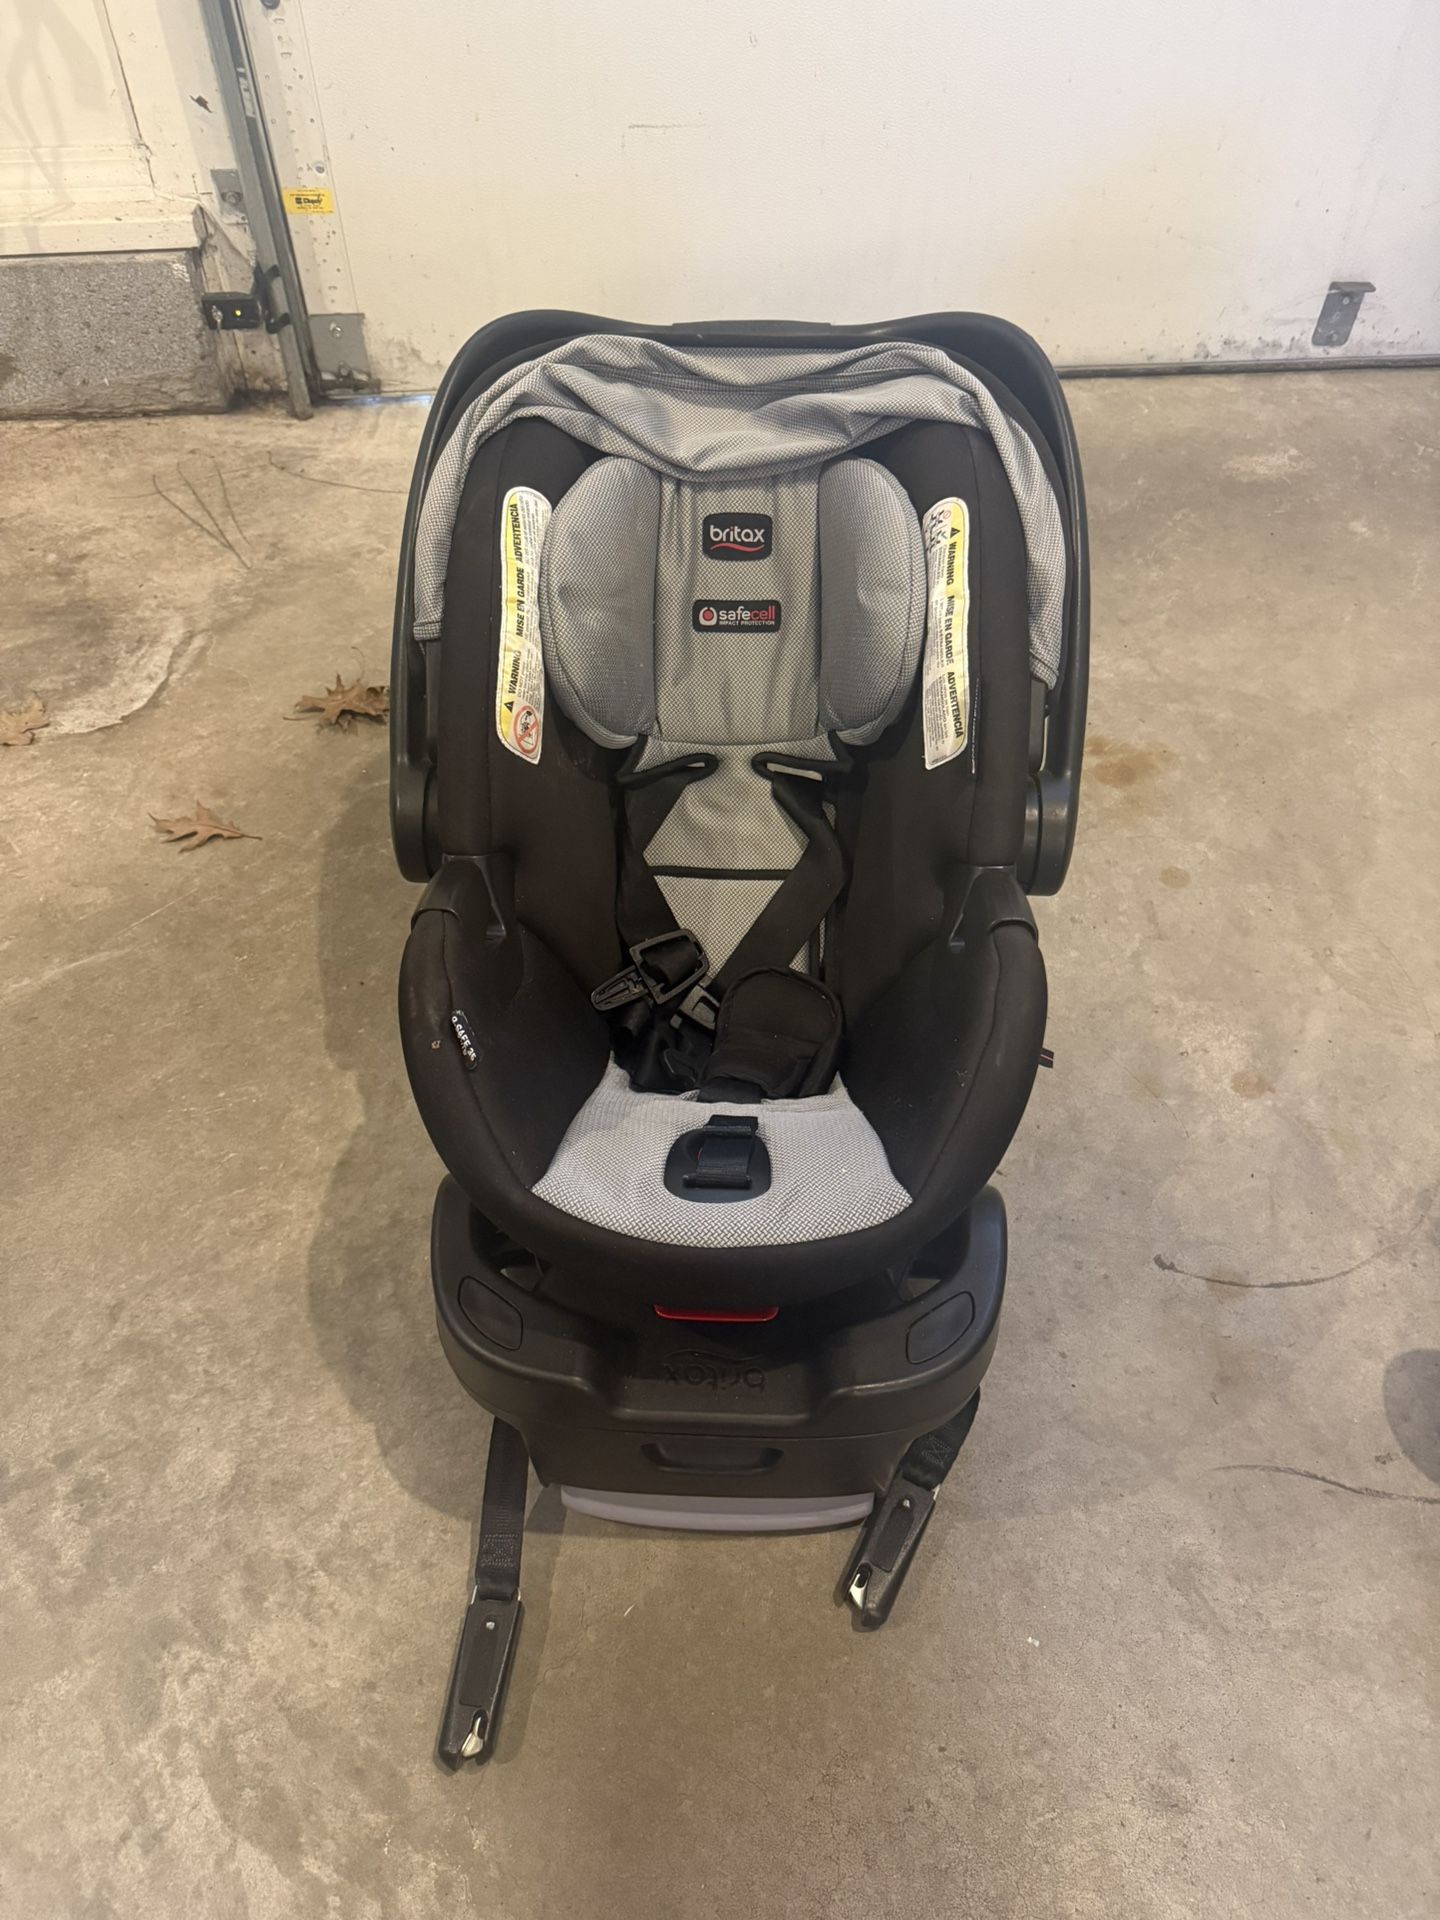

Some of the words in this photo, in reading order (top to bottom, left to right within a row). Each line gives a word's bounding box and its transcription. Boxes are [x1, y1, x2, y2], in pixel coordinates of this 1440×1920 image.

[509, 503, 524, 564] ADVERTENCIA
[709, 524, 765, 543] britax
[946, 541, 958, 586] WARNING
[516, 566, 526, 598] GARDE
[516, 599, 526, 614] EN
[718, 605, 776, 621] safecell
[944, 595, 956, 617] MISE
[516, 614, 526, 638] MISE
[944, 617, 953, 632] EN
[944, 632, 955, 667] GARDE
[508, 651, 522, 695] WARNING
[946, 671, 964, 739] ADVERTENCIA
